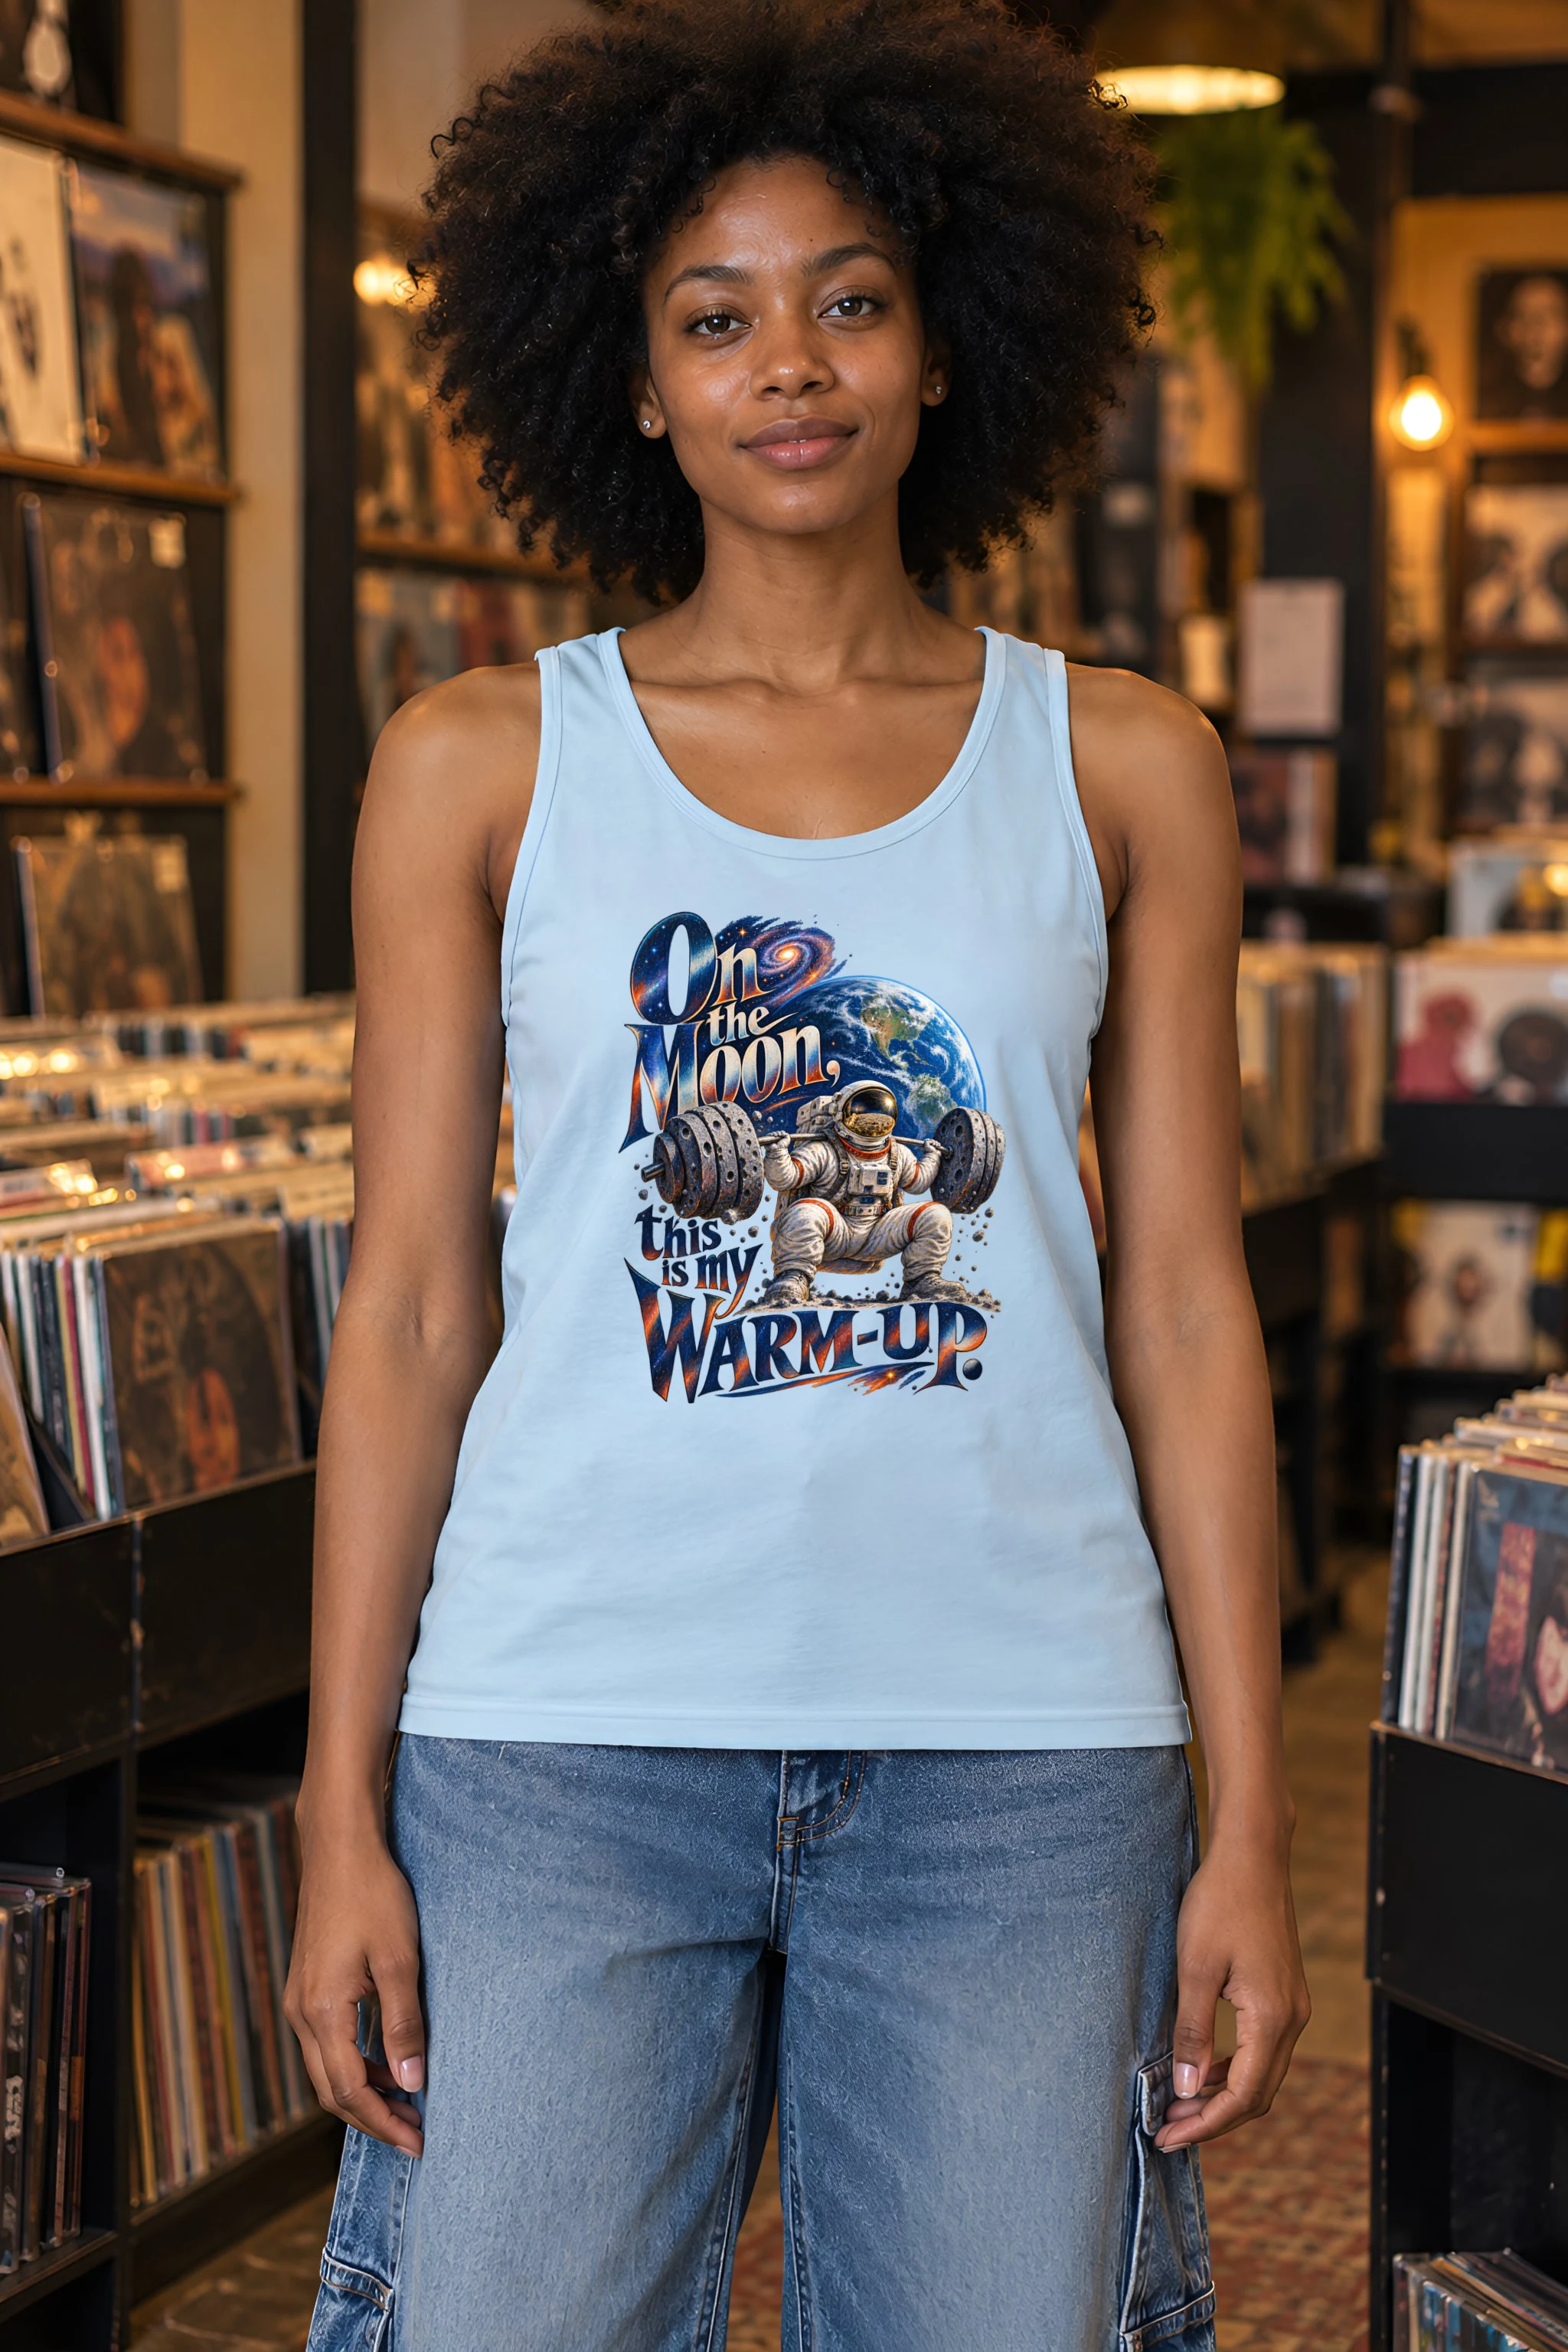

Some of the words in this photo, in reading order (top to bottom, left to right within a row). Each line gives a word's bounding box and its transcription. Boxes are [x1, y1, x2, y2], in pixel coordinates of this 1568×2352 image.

[629, 911, 776, 1025] On
[705, 1002, 798, 1047] the
[619, 1021, 841, 1153] Moon,
[634, 1204, 722, 1261] this
[662, 1259, 689, 1288] is
[695, 1243, 763, 1319] my
